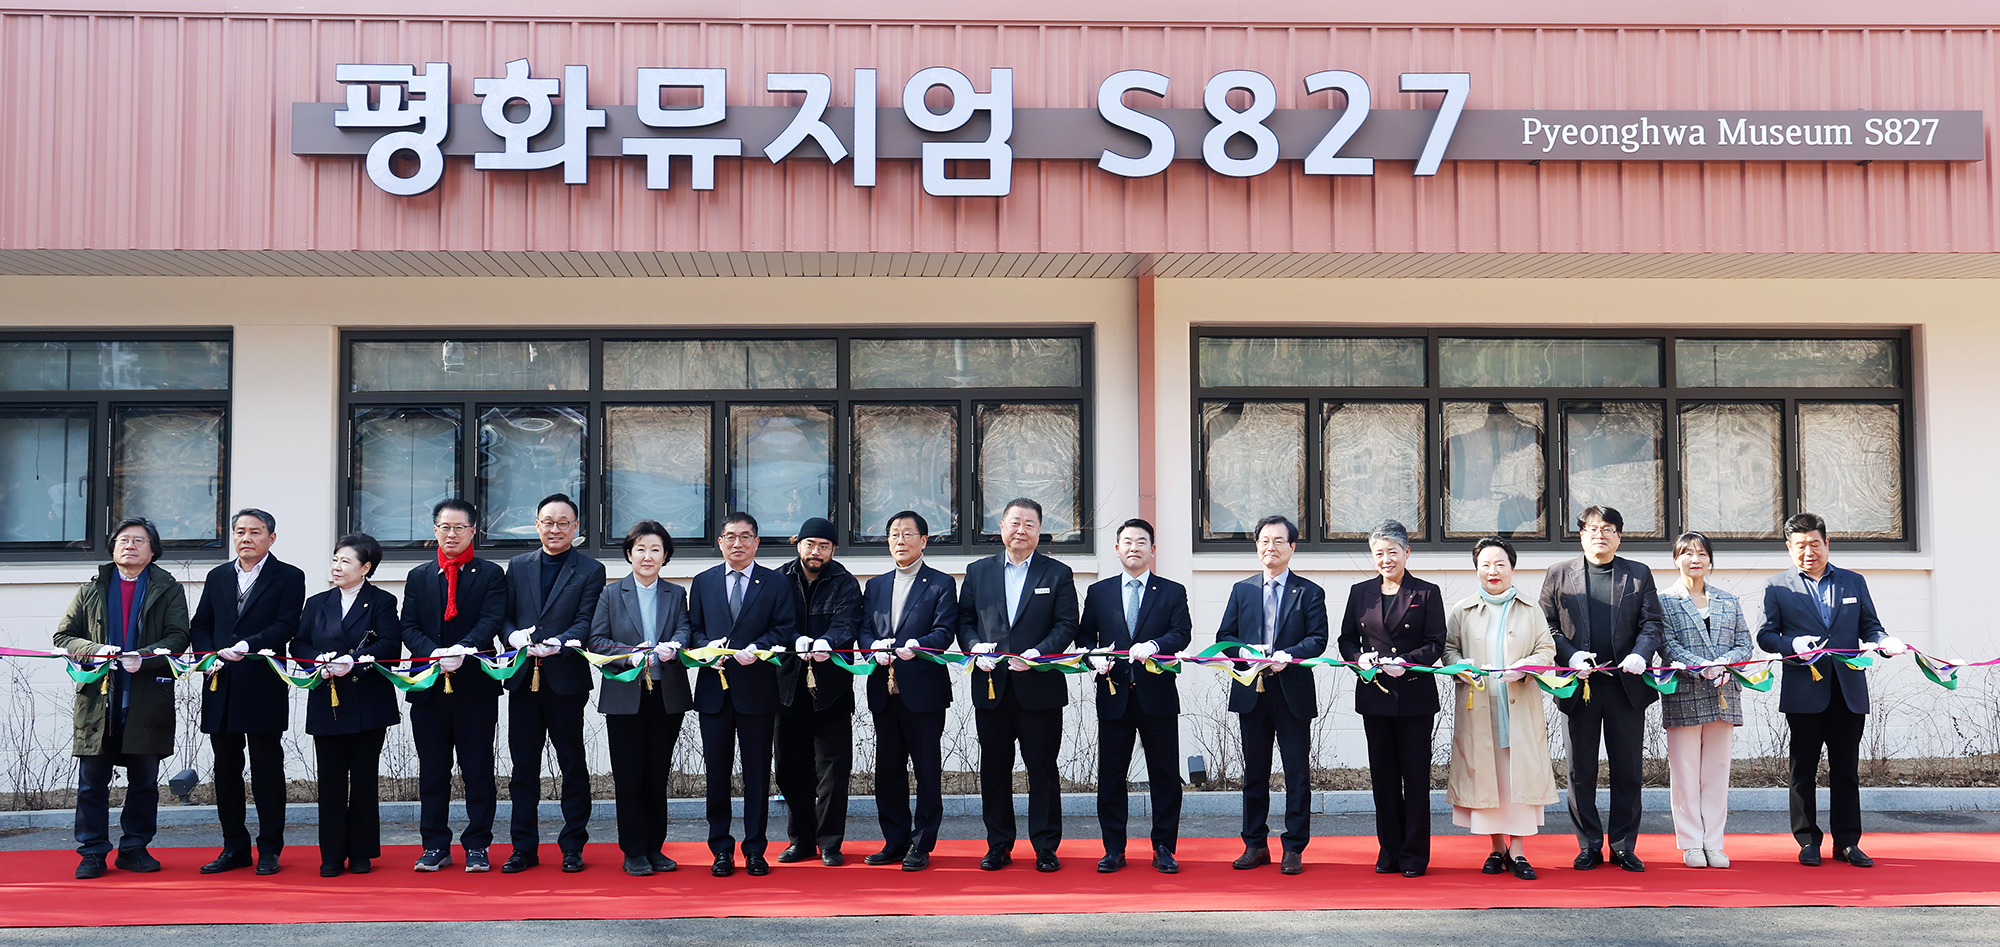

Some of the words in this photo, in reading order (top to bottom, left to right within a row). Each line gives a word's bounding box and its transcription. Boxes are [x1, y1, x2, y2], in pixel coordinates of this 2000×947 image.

[334, 58, 1014, 197] 평화뮤지엄
[1097, 70, 1472, 178] S827
[1521, 116, 1707, 153] Pyeonghwa
[1717, 118, 1854, 146] Museum
[1864, 117, 1940, 146] S827
